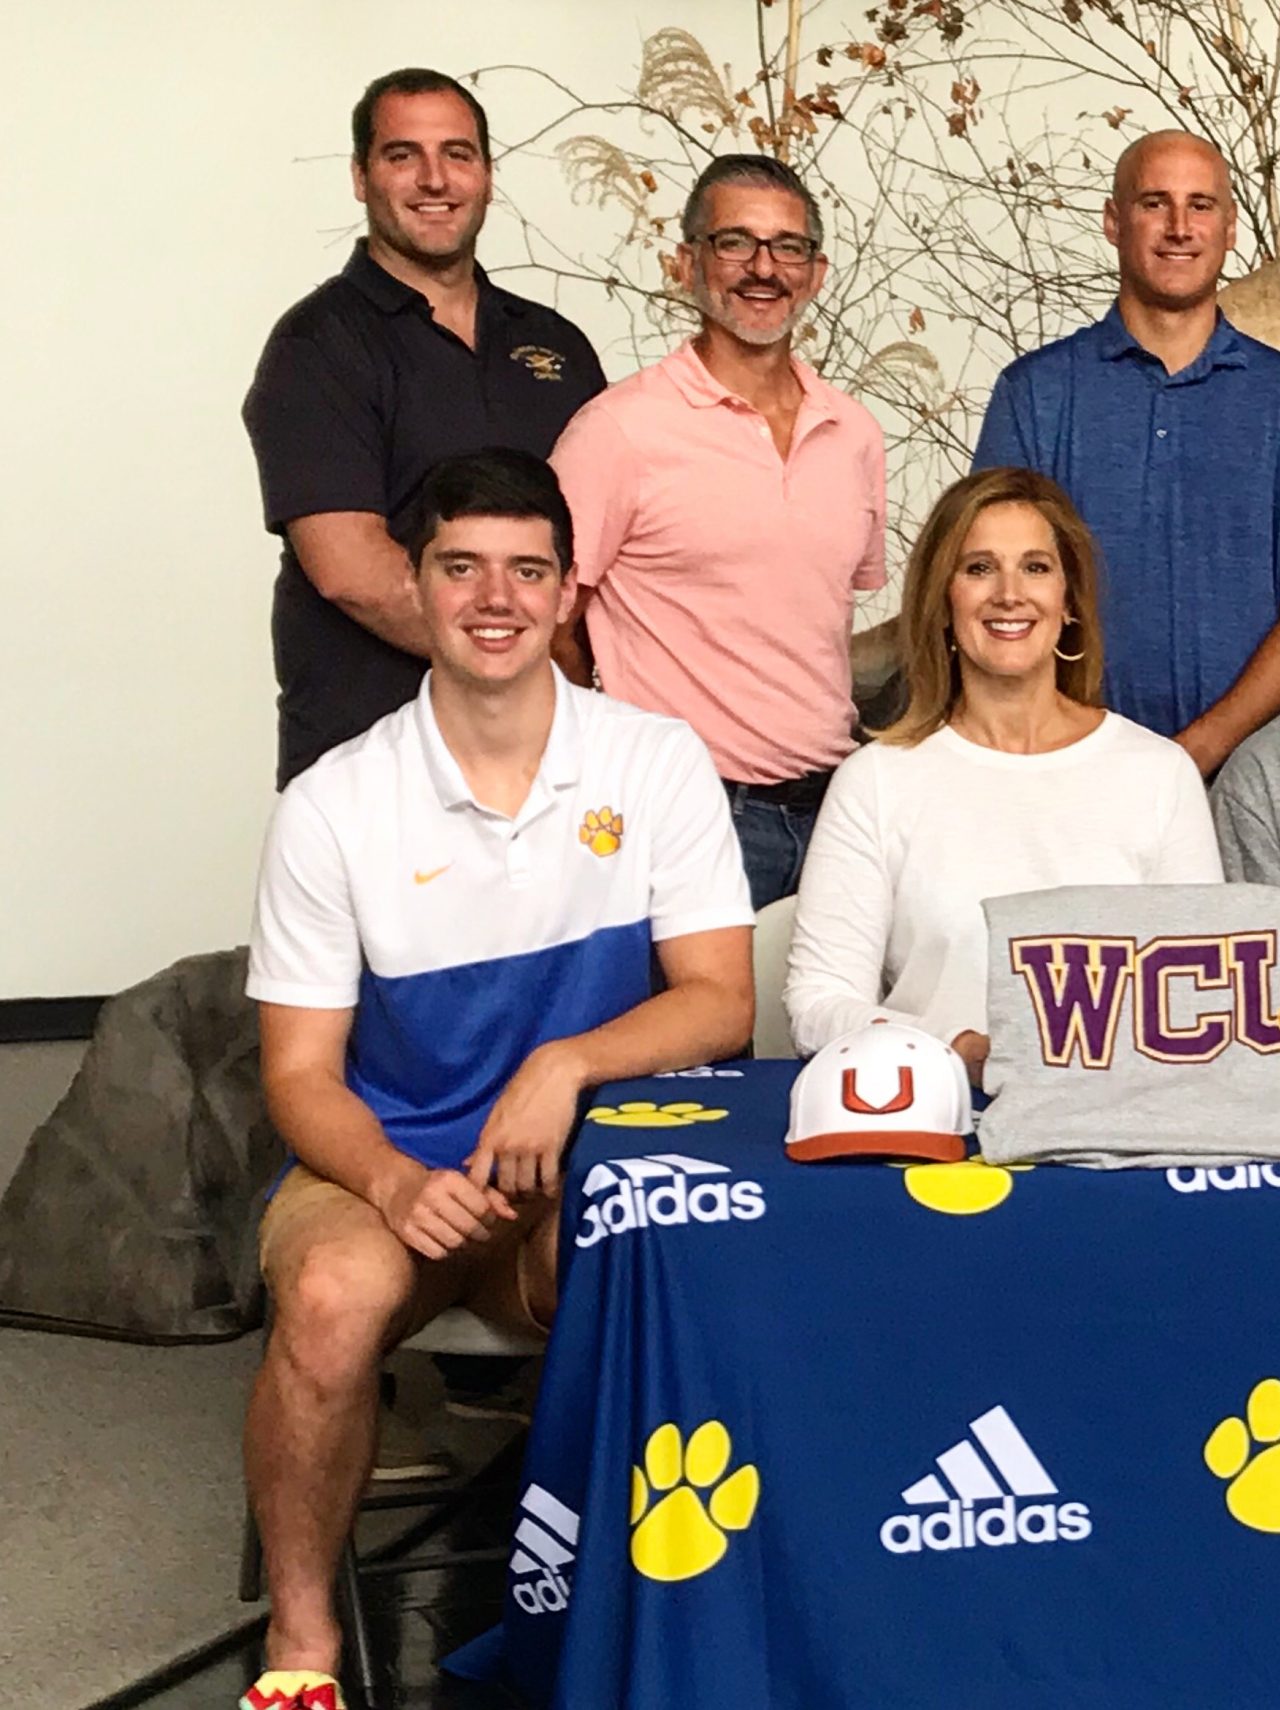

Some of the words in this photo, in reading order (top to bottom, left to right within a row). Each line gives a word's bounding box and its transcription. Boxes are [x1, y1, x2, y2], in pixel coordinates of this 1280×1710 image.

[841, 1066, 914, 1116] U
[574, 1173, 767, 1248] adidas
[880, 1494, 1093, 1555] adidas
[512, 1566, 571, 1615] adi
